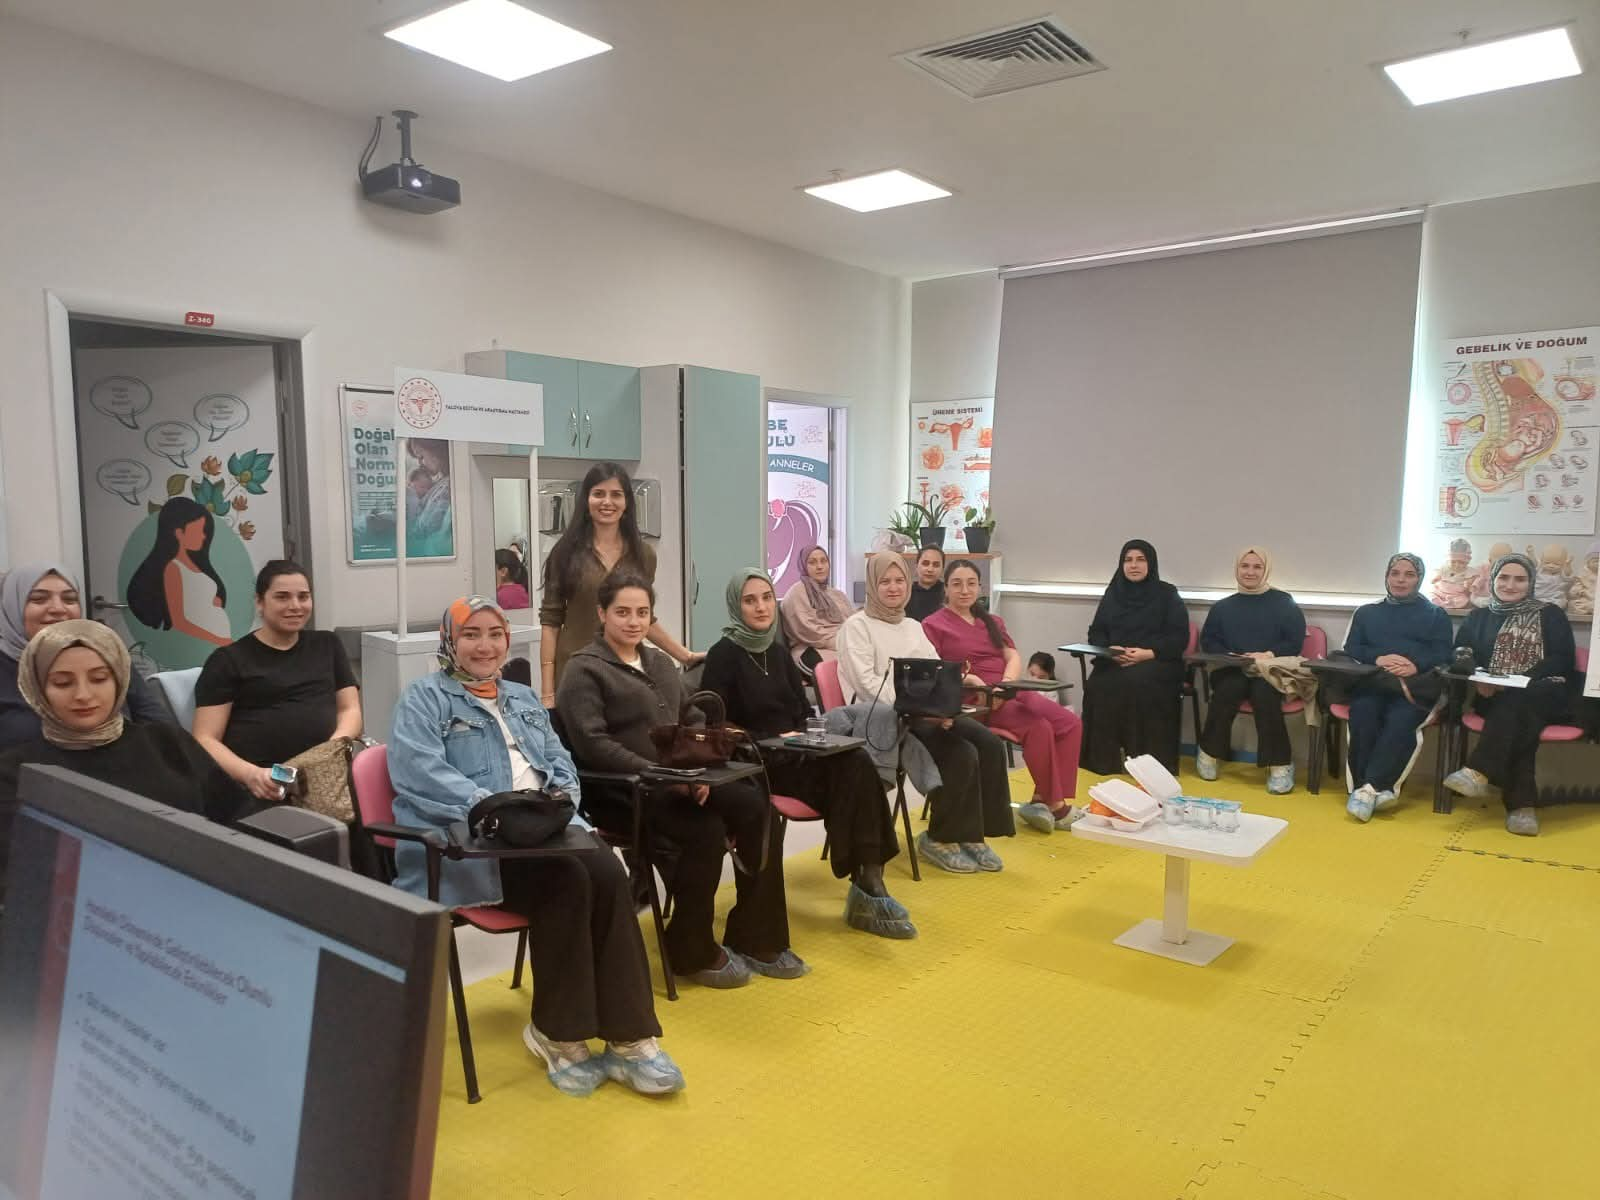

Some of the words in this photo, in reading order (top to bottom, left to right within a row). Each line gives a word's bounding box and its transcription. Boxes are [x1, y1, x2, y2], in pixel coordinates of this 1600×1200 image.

[1457, 343, 1511, 355] GEBELİK
[1515, 341, 1532, 350] VE
[1537, 336, 1588, 348] DOĞUM
[768, 419, 788, 430] BE
[354, 428, 395, 443] Doğal
[768, 435, 795, 447] ULU
[355, 442, 388, 455] Olan
[356, 457, 395, 470] Norm
[769, 458, 815, 473] ANNELER
[357, 473, 395, 488] Doğu
